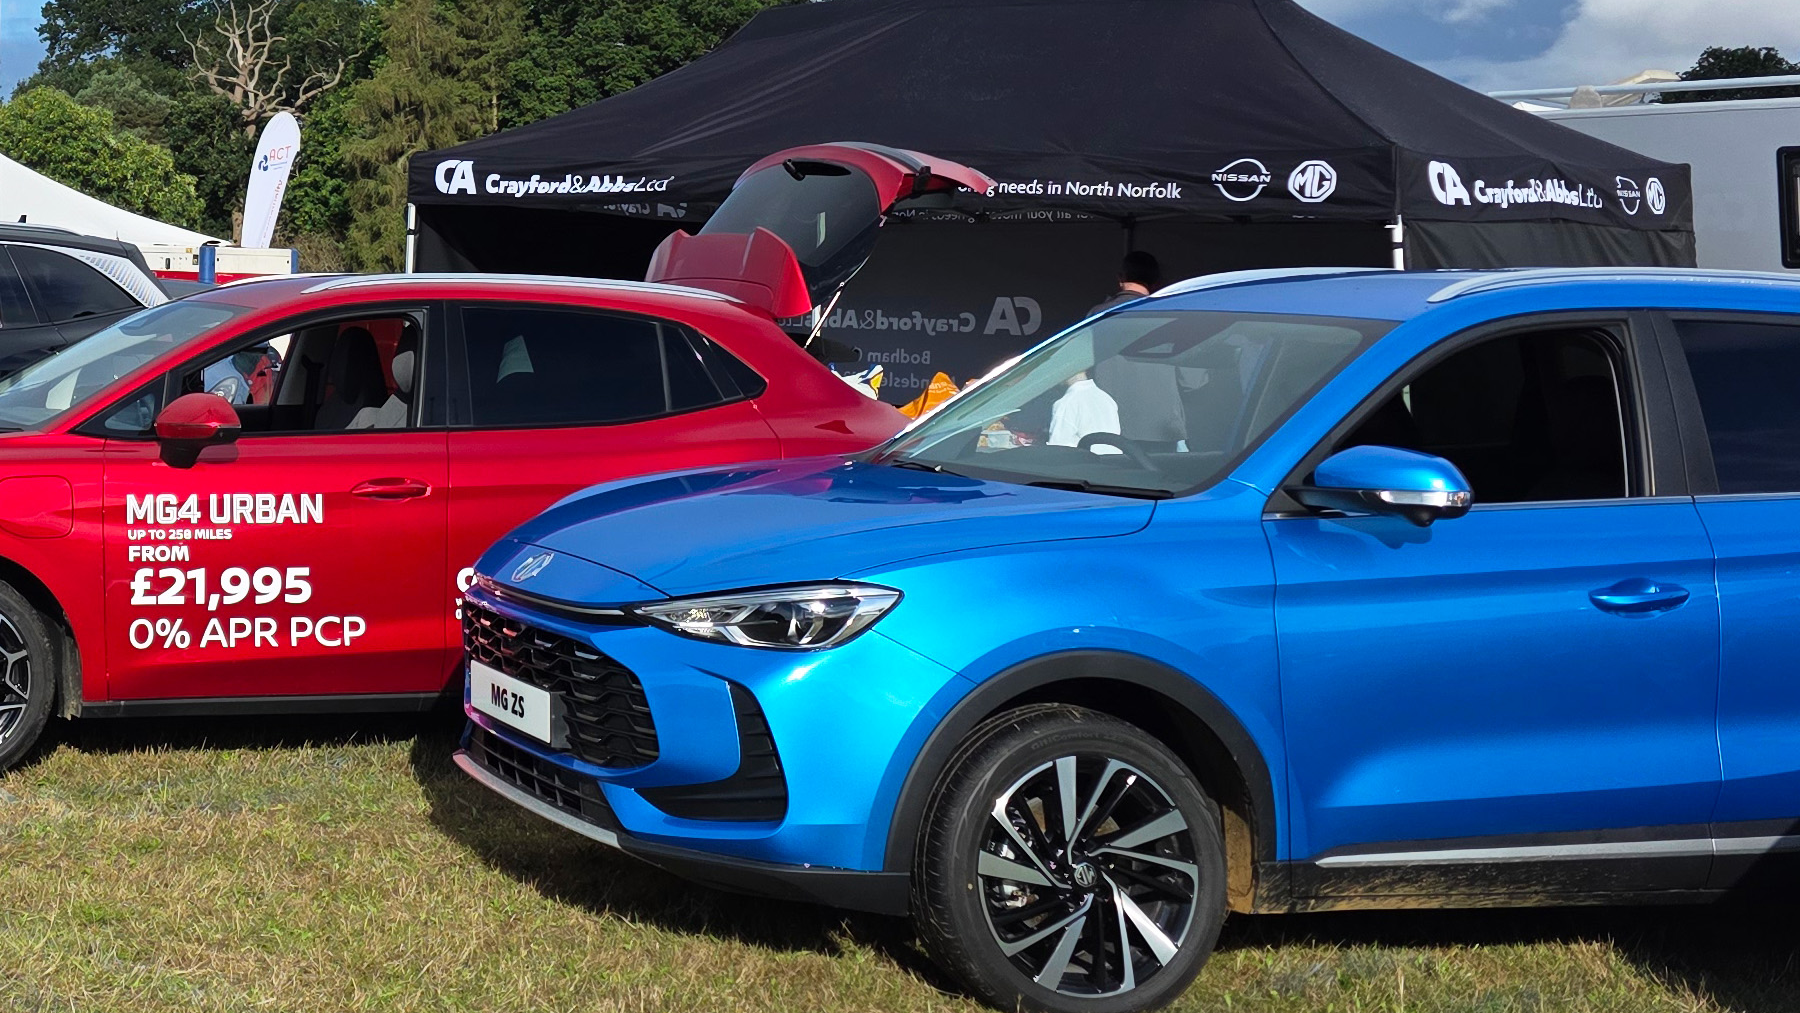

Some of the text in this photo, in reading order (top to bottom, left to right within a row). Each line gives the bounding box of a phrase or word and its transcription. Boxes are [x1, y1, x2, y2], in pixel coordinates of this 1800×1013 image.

[269, 145, 292, 161] ACT
[434, 159, 477, 195] CA
[998, 179, 1044, 196] needs
[1047, 179, 1062, 195] in
[1065, 181, 1114, 197] North
[1117, 181, 1182, 199] Norfolk
[1211, 163, 1334, 199] NISSAN MG
[1428, 160, 1472, 206] CA
[1647, 180, 1664, 213] MG
[126, 492, 323, 525] MG4 URBAN
[127, 528, 233, 540] UP TO 258 MILES
[128, 545, 190, 562] FROM
[129, 566, 313, 612] £21,995
[129, 615, 367, 650] 0% APR PCP
[490, 682, 525, 719] MG ZS
